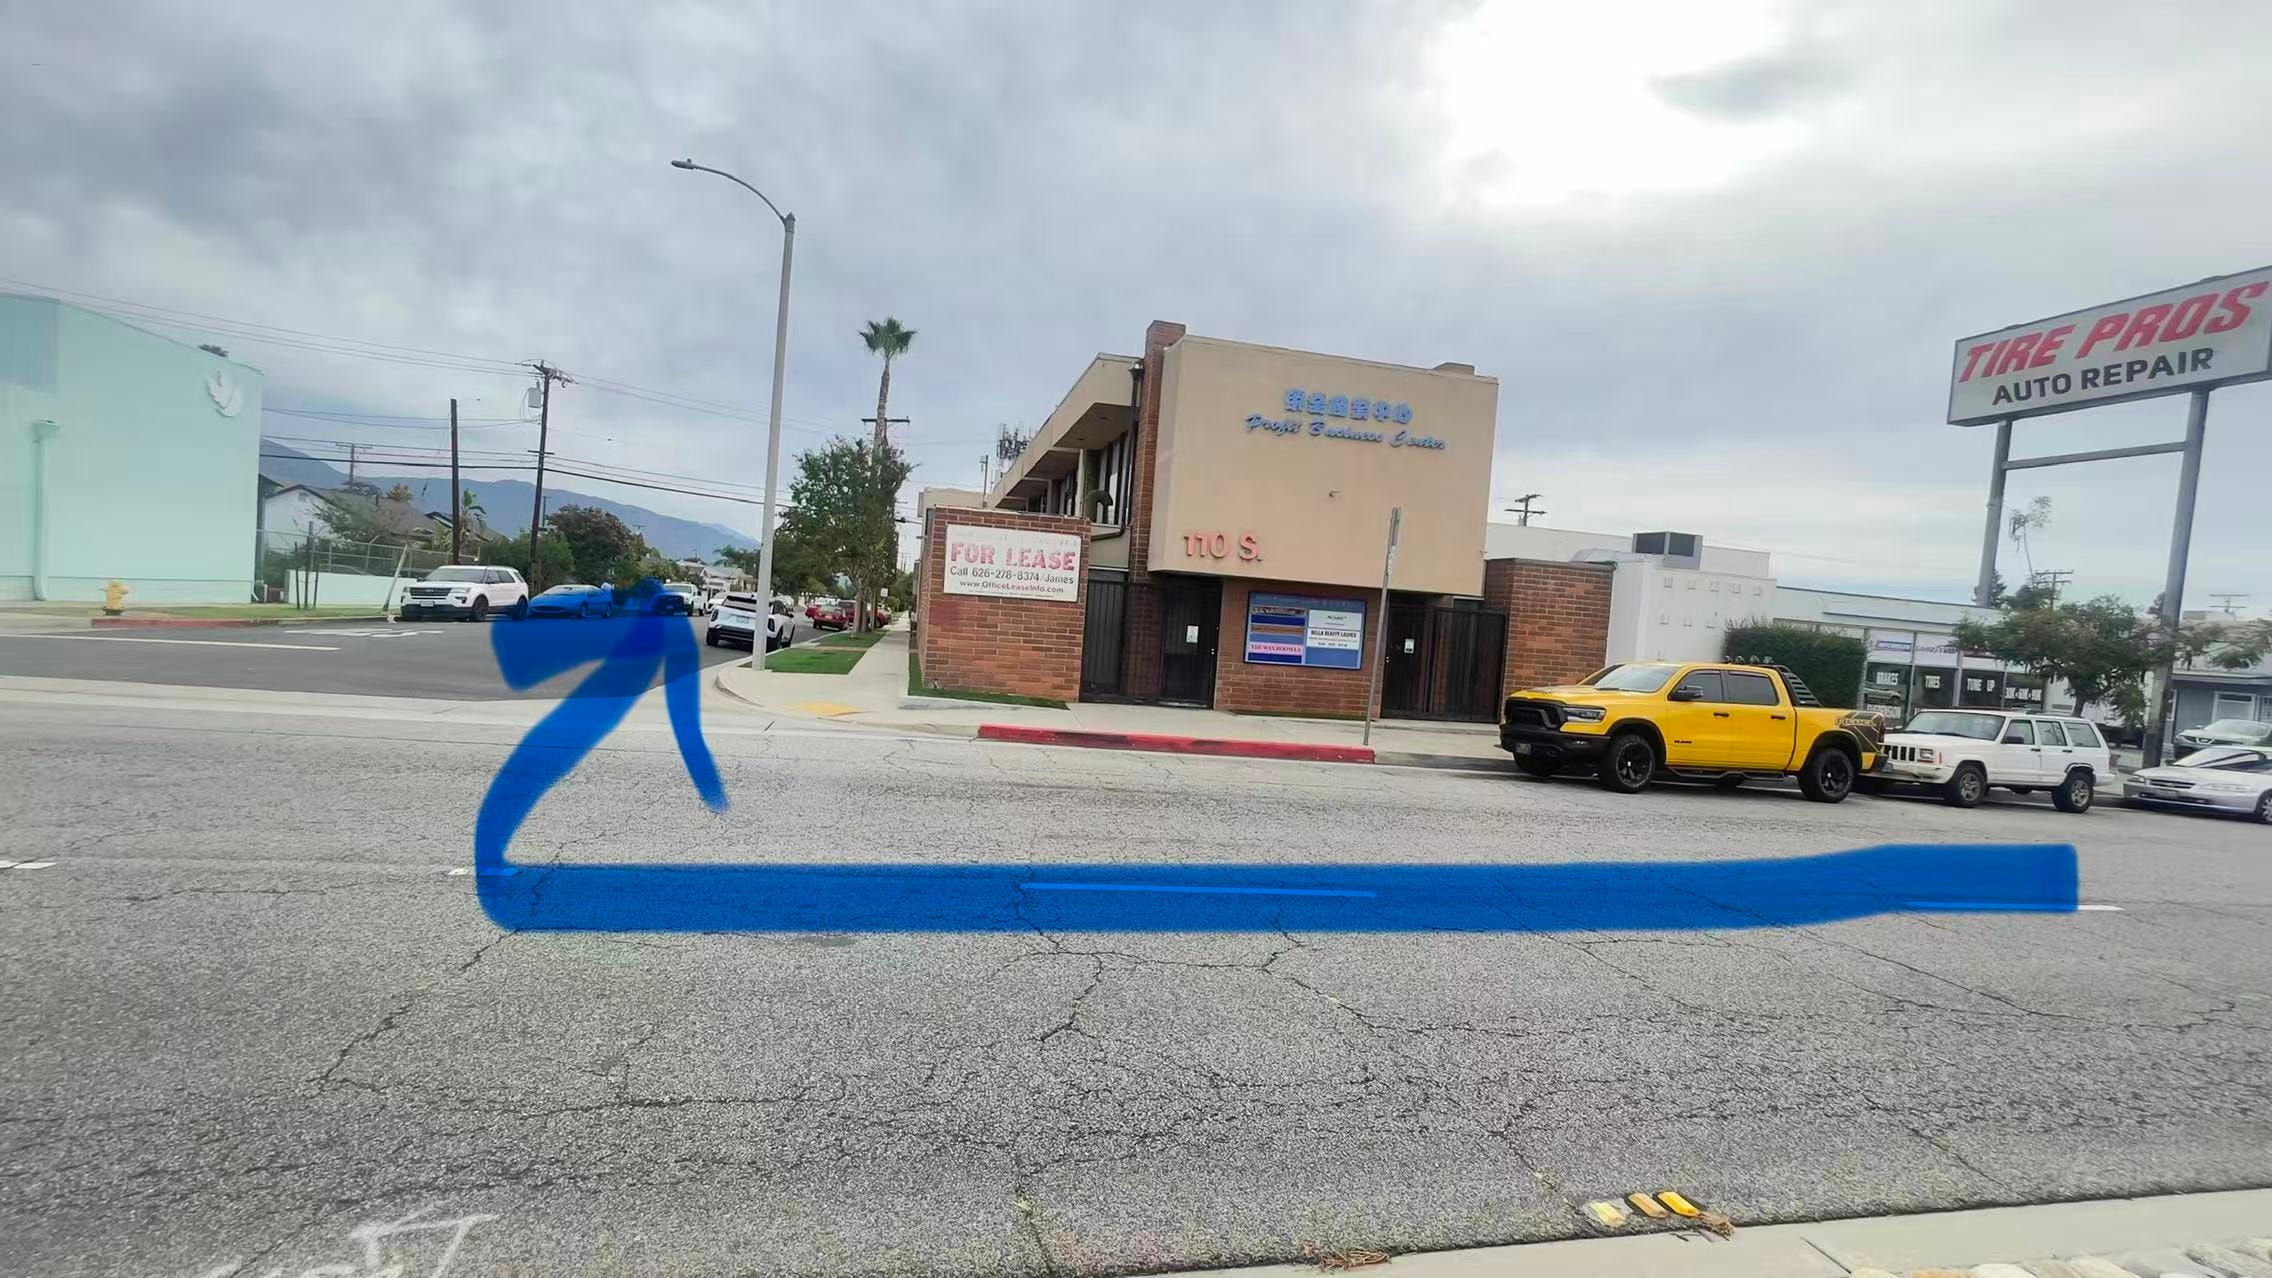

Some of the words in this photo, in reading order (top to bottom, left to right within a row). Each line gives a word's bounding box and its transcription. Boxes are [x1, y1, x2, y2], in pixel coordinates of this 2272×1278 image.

[1959, 324, 2076, 382] TIRE
[2075, 281, 2270, 359] PROS
[1992, 373, 2072, 405] AUTO
[2081, 347, 2214, 389] REPAIR
[1308, 419, 1384, 442] Business
[1389, 429, 1446, 449] Center
[951, 543, 995, 564] FOR
[1005, 547, 1076, 571] LEASE
[1183, 531, 1231, 559] 110
[950, 566, 968, 576] Call
[1876, 672, 1898, 686] BRAKES
